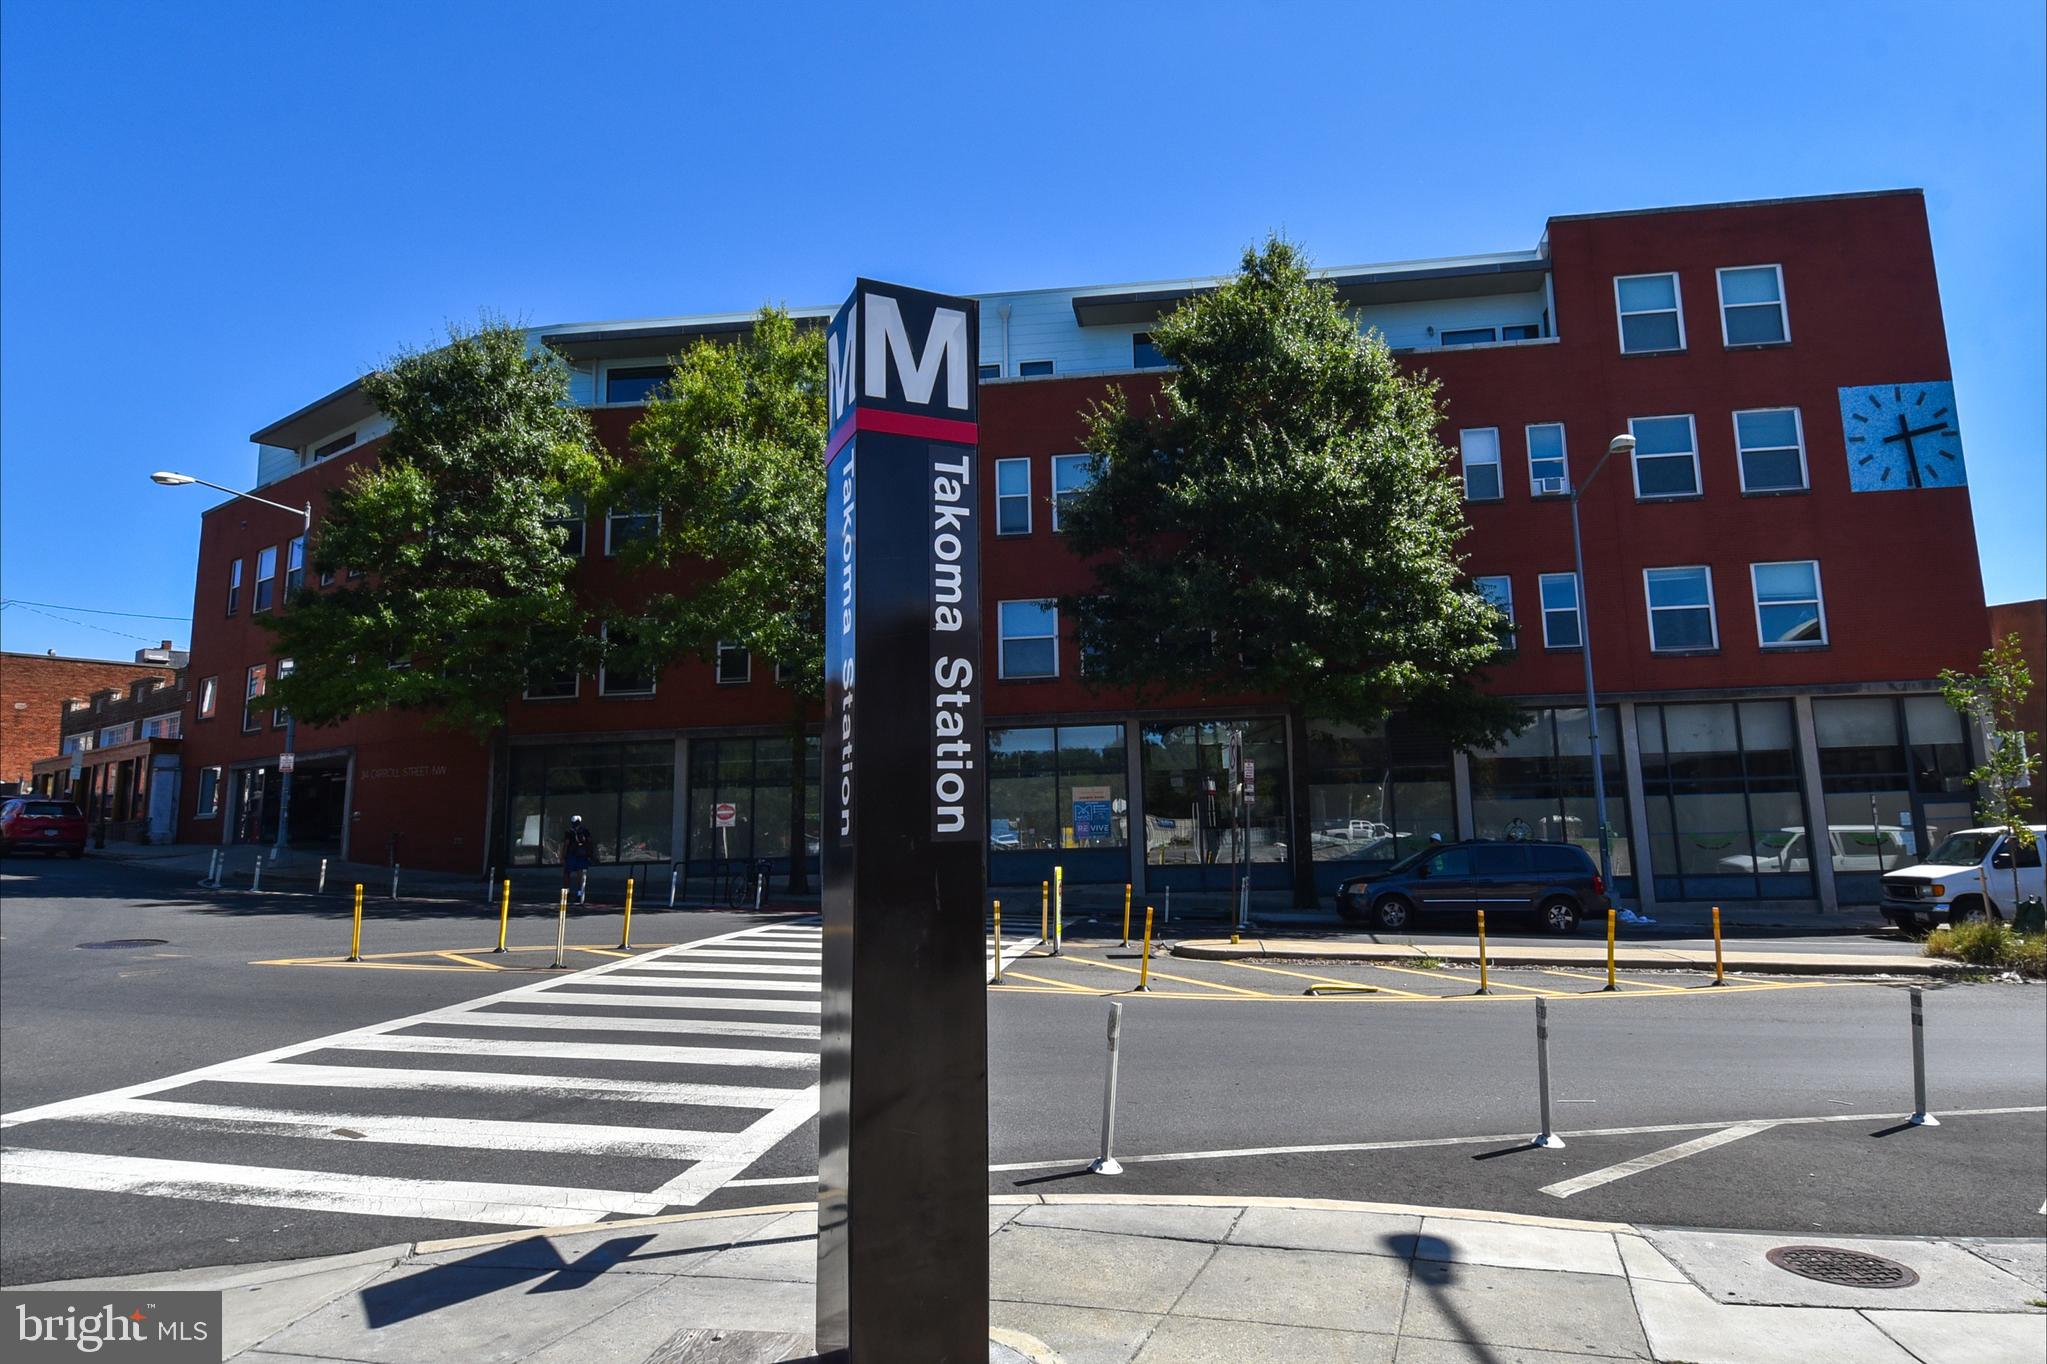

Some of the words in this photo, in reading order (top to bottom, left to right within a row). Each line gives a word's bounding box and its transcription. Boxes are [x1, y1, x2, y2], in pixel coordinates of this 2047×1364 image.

[828, 302, 857, 430] M
[865, 293, 968, 410] M
[842, 448, 855, 635] Takoma
[934, 456, 970, 632] Takoma
[402, 765, 430, 777] STREET
[841, 657, 854, 836] Station
[935, 656, 973, 833] Station
